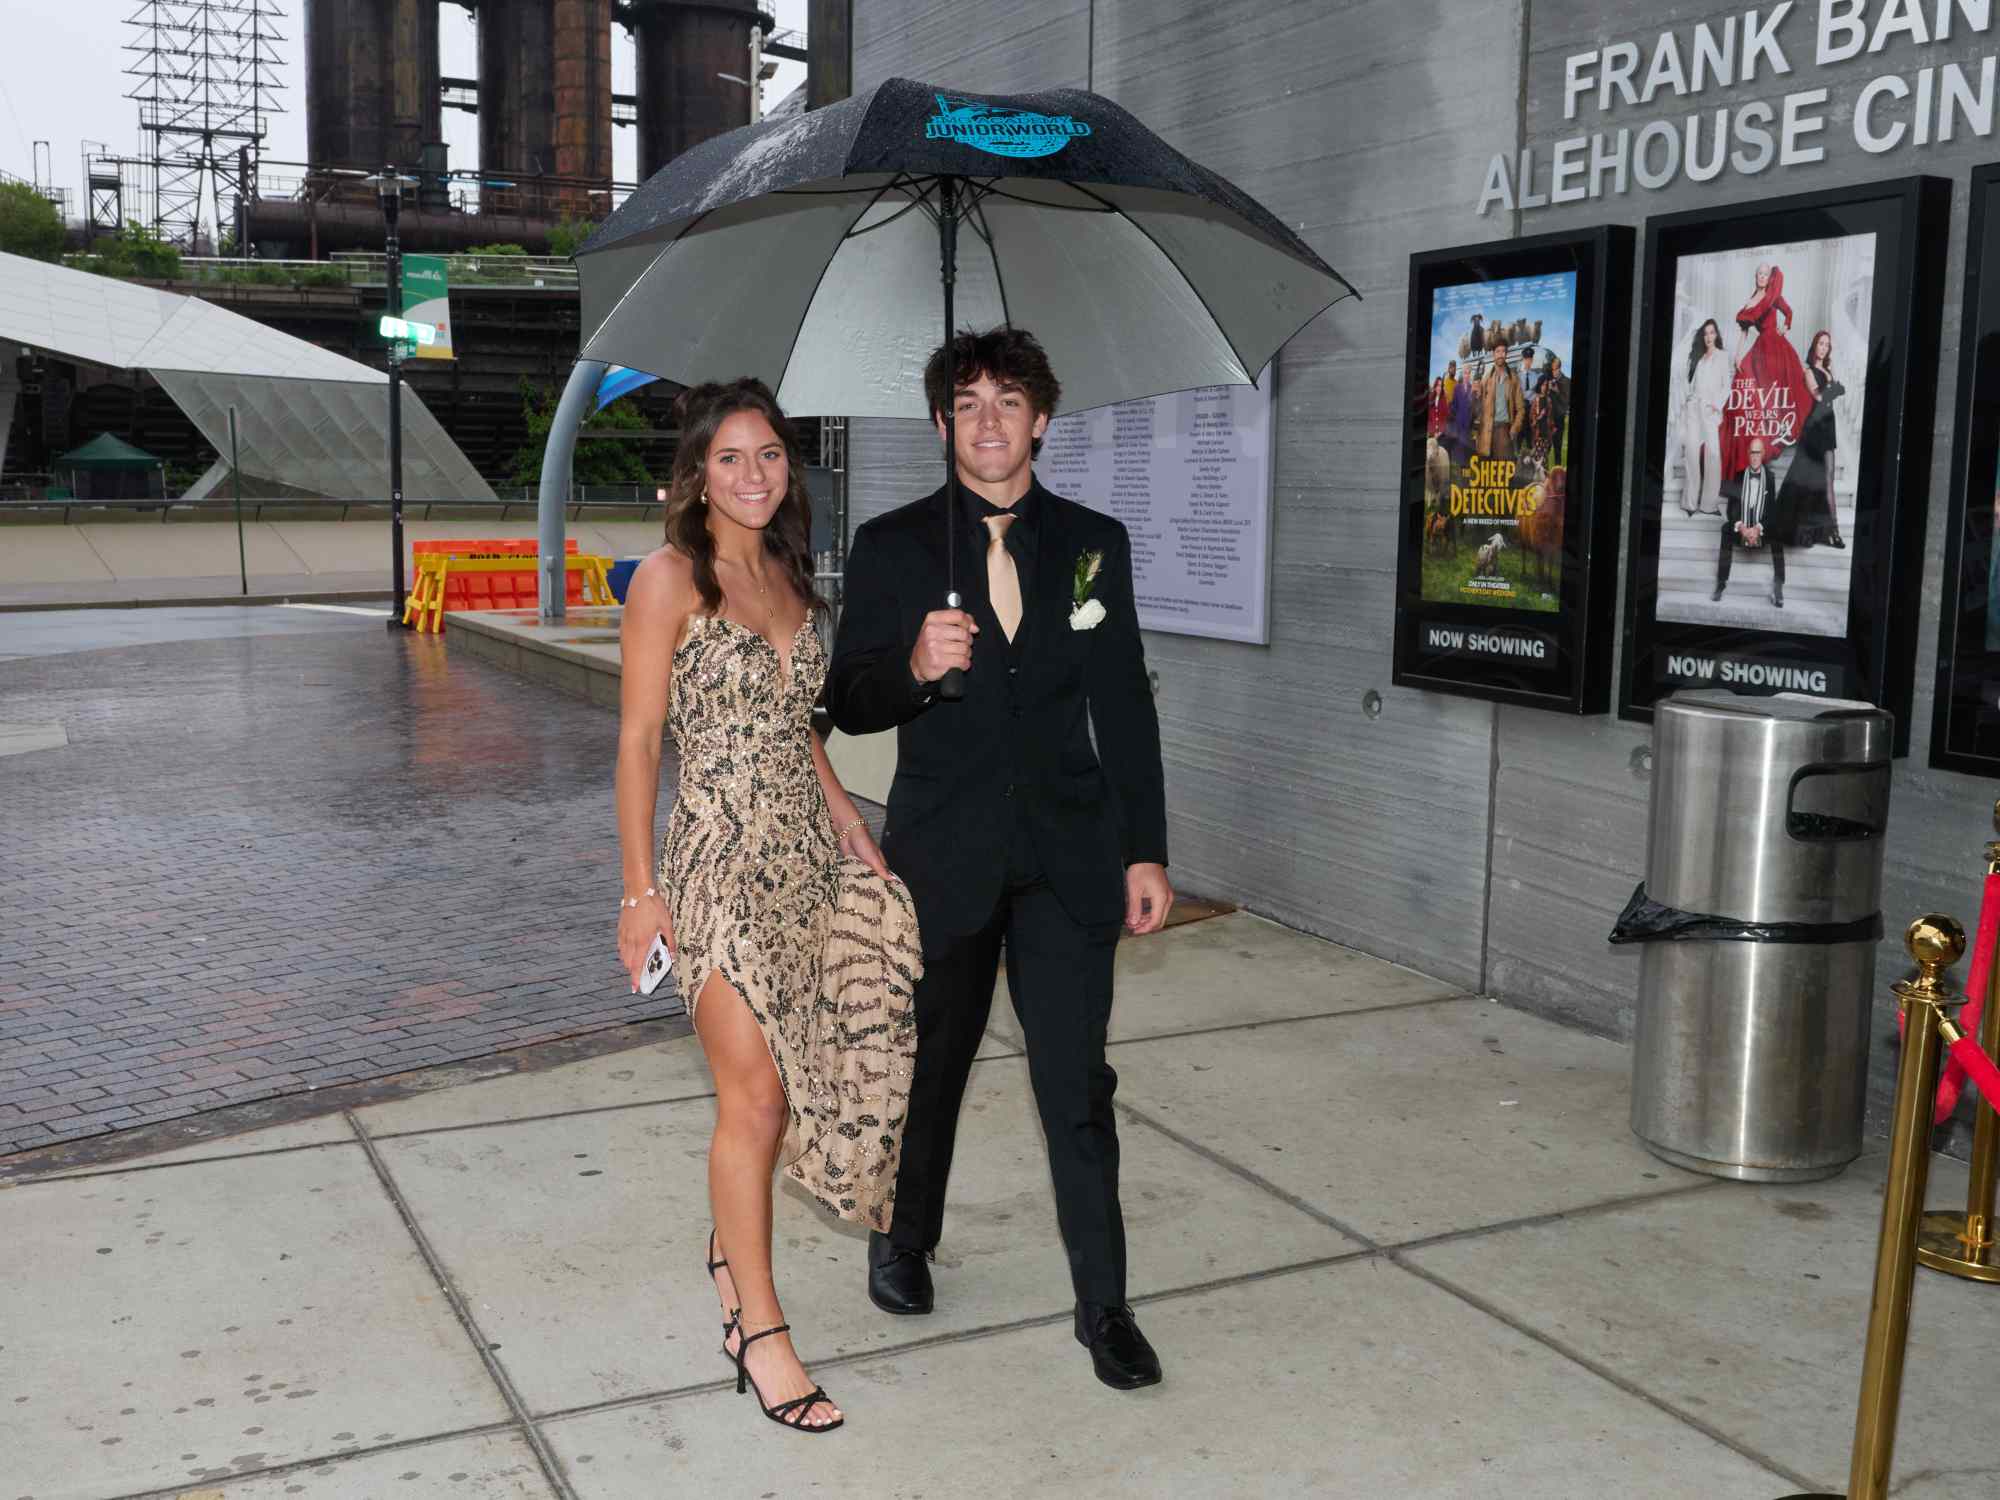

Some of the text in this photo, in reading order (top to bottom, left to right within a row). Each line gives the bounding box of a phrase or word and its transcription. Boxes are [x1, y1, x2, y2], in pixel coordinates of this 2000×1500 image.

[1564, 2, 1793, 119] FRANK
[928, 124, 1087, 136] JUNIOR WORLD
[1476, 56, 1998, 215] ALEHOUSE CIN
[1728, 380, 1796, 410] DEVIL
[1736, 378, 1756, 388] THE
[1744, 409, 1778, 419] WEARS
[1470, 455, 1516, 487] SHEEP
[1451, 483, 1537, 517] DETECTIVES
[1429, 629, 1544, 658] NOW SHOWING
[1667, 655, 1826, 692] NOW SHOWING
